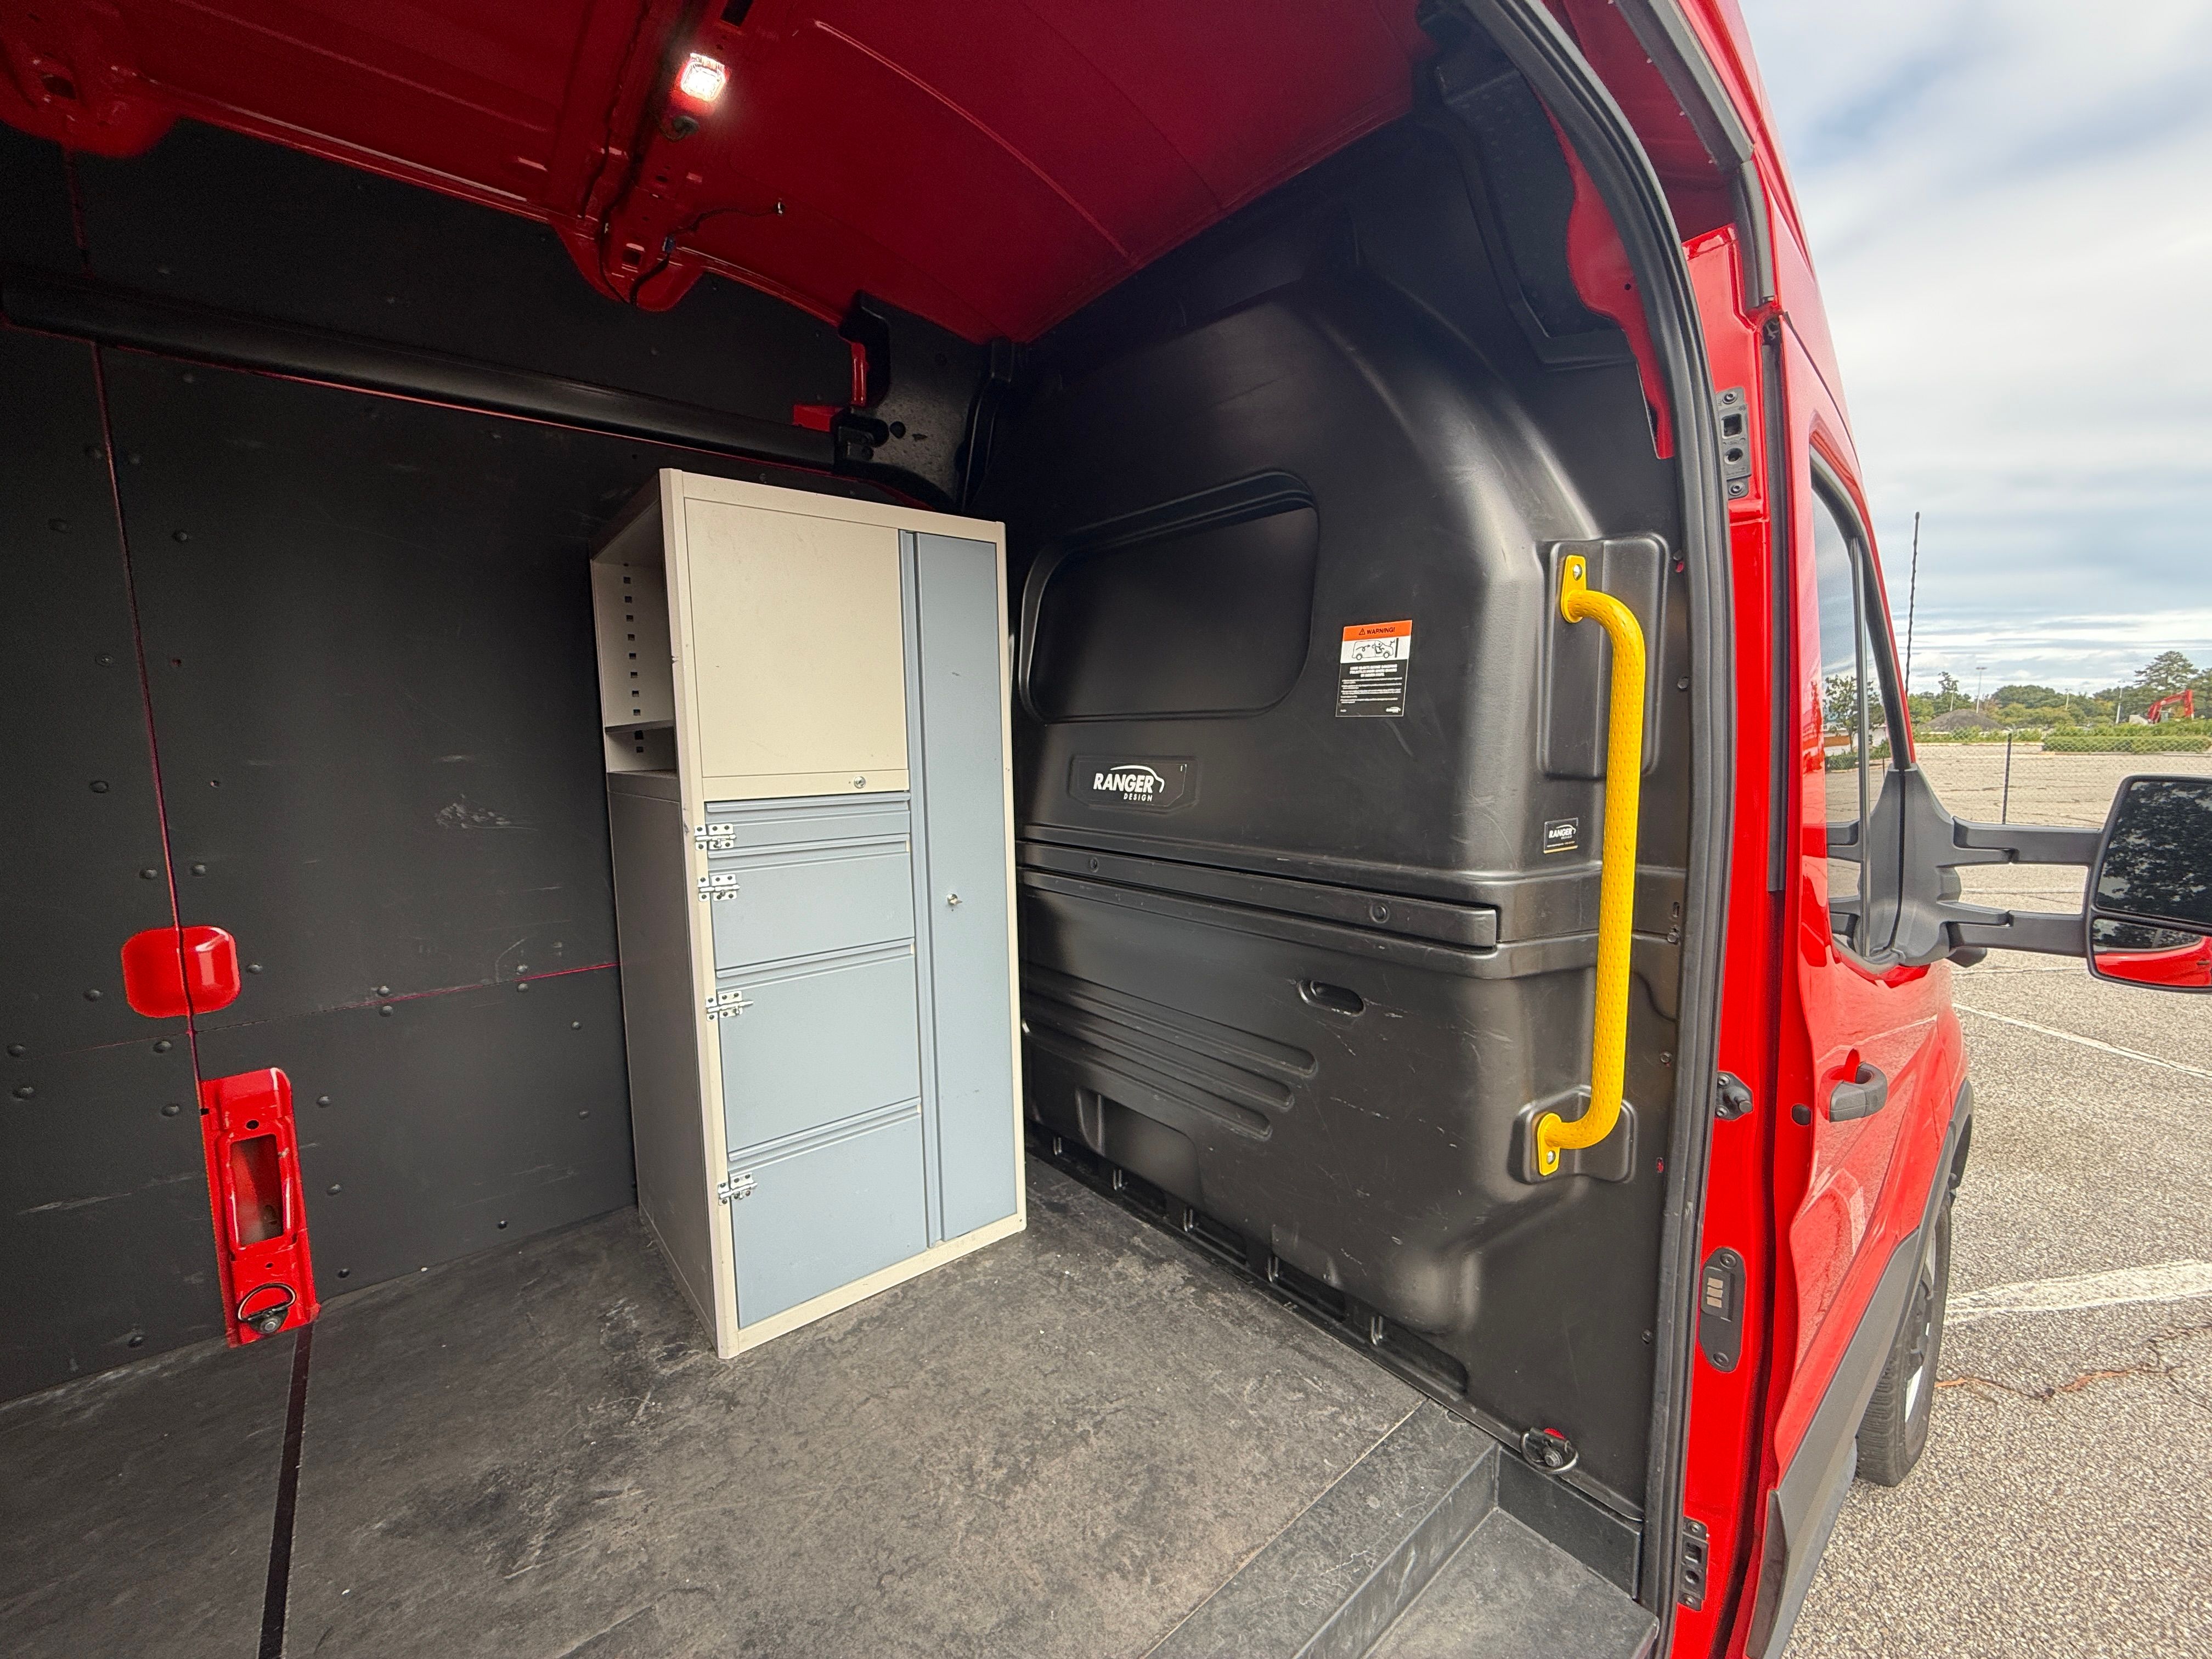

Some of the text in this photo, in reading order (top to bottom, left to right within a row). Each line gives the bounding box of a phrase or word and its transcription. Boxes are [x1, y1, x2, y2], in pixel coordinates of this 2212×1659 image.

[1093, 773, 1154, 793] RANGER
[1123, 793, 1153, 802] DESIGN
[1548, 828, 1573, 839] RANGER
